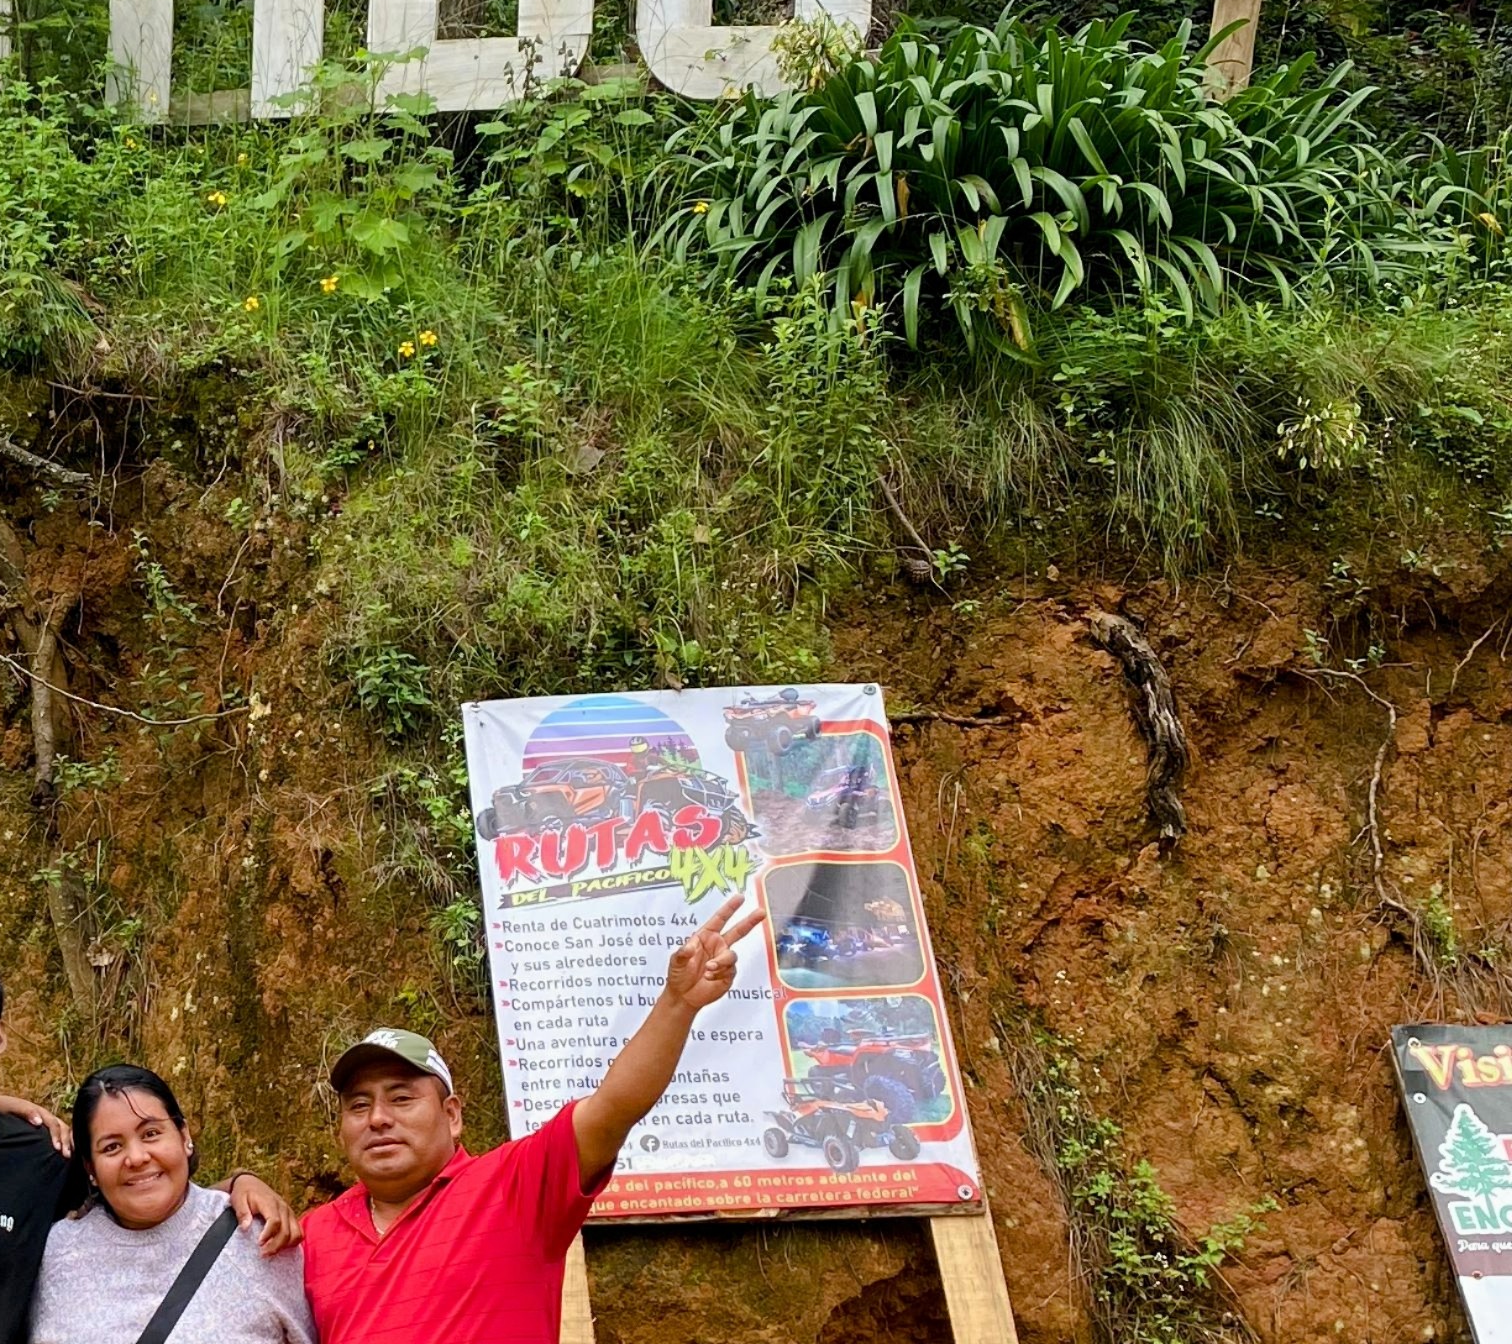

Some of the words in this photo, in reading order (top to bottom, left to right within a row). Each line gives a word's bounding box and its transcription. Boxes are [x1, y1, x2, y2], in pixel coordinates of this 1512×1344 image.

[493, 804, 723, 884] RUTAS
[511, 887, 556, 906] DEL
[572, 868, 672, 894] PACIFICO
[502, 919, 545, 934] Renta
[550, 918, 568, 932] de
[572, 913, 666, 929] Cuatrimotos
[670, 912, 698, 927] 4x4
[504, 938, 560, 953] Conoce
[564, 936, 594, 950] San
[598, 931, 634, 948] José
[638, 933, 663, 947] del
[510, 960, 520, 975] y
[524, 960, 551, 972] sus
[555, 954, 648, 970] alrededores
[509, 974, 593, 991] Recorridos
[598, 973, 669, 987] nocturno
[511, 994, 613, 1013] Compártenos
[618, 994, 634, 1007] tu
[638, 993, 657, 1007] bu
[728, 986, 788, 1000] musical
[514, 1020, 532, 1031] en
[537, 1015, 573, 1030] cada
[578, 1014, 609, 1028] ruta
[516, 1036, 546, 1051] Una
[550, 1034, 618, 1050] aventura
[691, 1027, 706, 1041] te
[710, 1027, 764, 1044] espera
[519, 1056, 603, 1071] Recorridos
[1409, 1043, 1512, 1091] Visi
[521, 1076, 561, 1092] entre
[713, 1090, 741, 1106] que
[651, 1113, 671, 1126] en
[675, 1110, 713, 1125] cada
[717, 1108, 754, 1124] ruta.
[662, 1138, 689, 1151] Rutas
[690, 1137, 705, 1149] del
[744, 1135, 761, 1147] 4x4
[625, 1179, 649, 1193] del
[733, 1174, 751, 1188] 60
[757, 1173, 815, 1187] metros
[819, 1171, 888, 1186] adelante
[892, 1168, 918, 1183] del
[705, 1192, 752, 1206] sobre
[756, 1192, 772, 1205] la
[775, 1189, 852, 1204] carretera
[1454, 1204, 1512, 1230] ENC
[1457, 1238, 1490, 1253] Para
